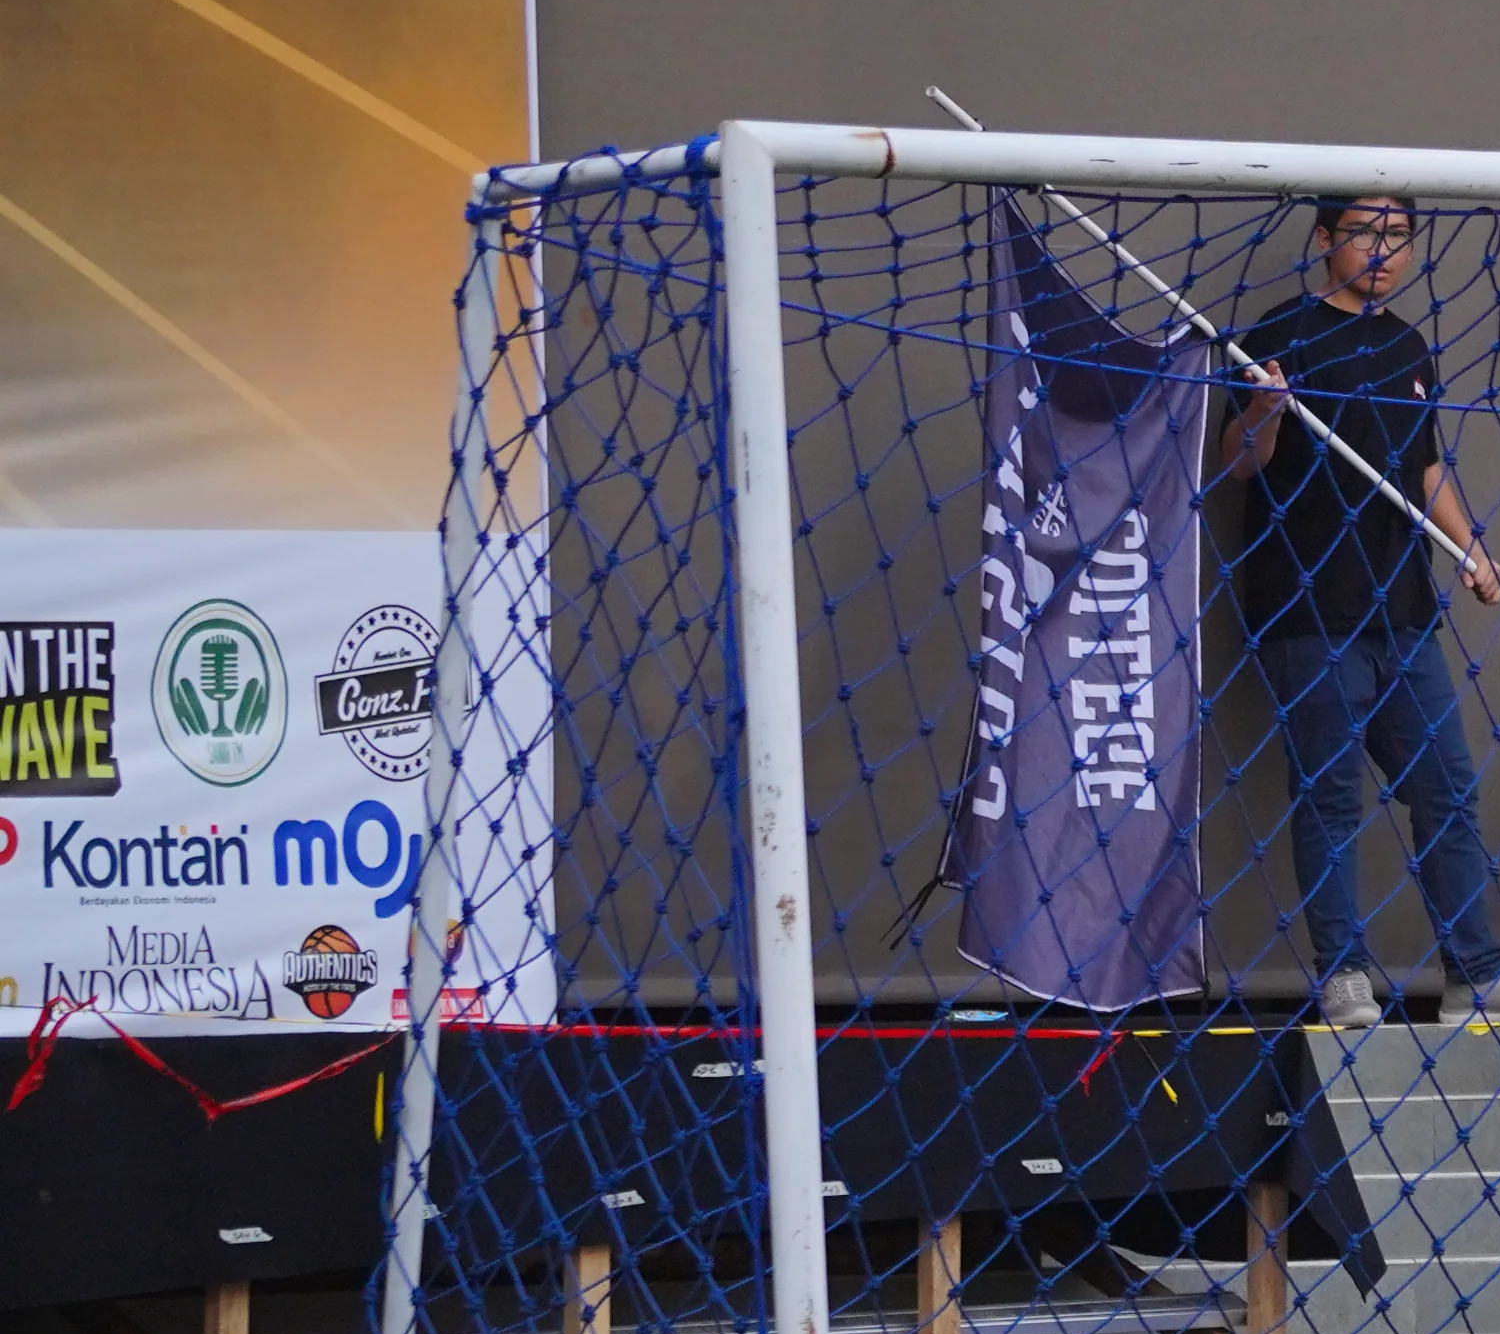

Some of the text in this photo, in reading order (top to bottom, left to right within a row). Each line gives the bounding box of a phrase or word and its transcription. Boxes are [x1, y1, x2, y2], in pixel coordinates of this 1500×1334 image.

[30, 628, 110, 694] THE
[44, 821, 249, 888] Kontan
[106, 924, 217, 966] MEDIA
[283, 950, 378, 985] AUTHENTICS
[43, 959, 275, 1022] INDONESIA
